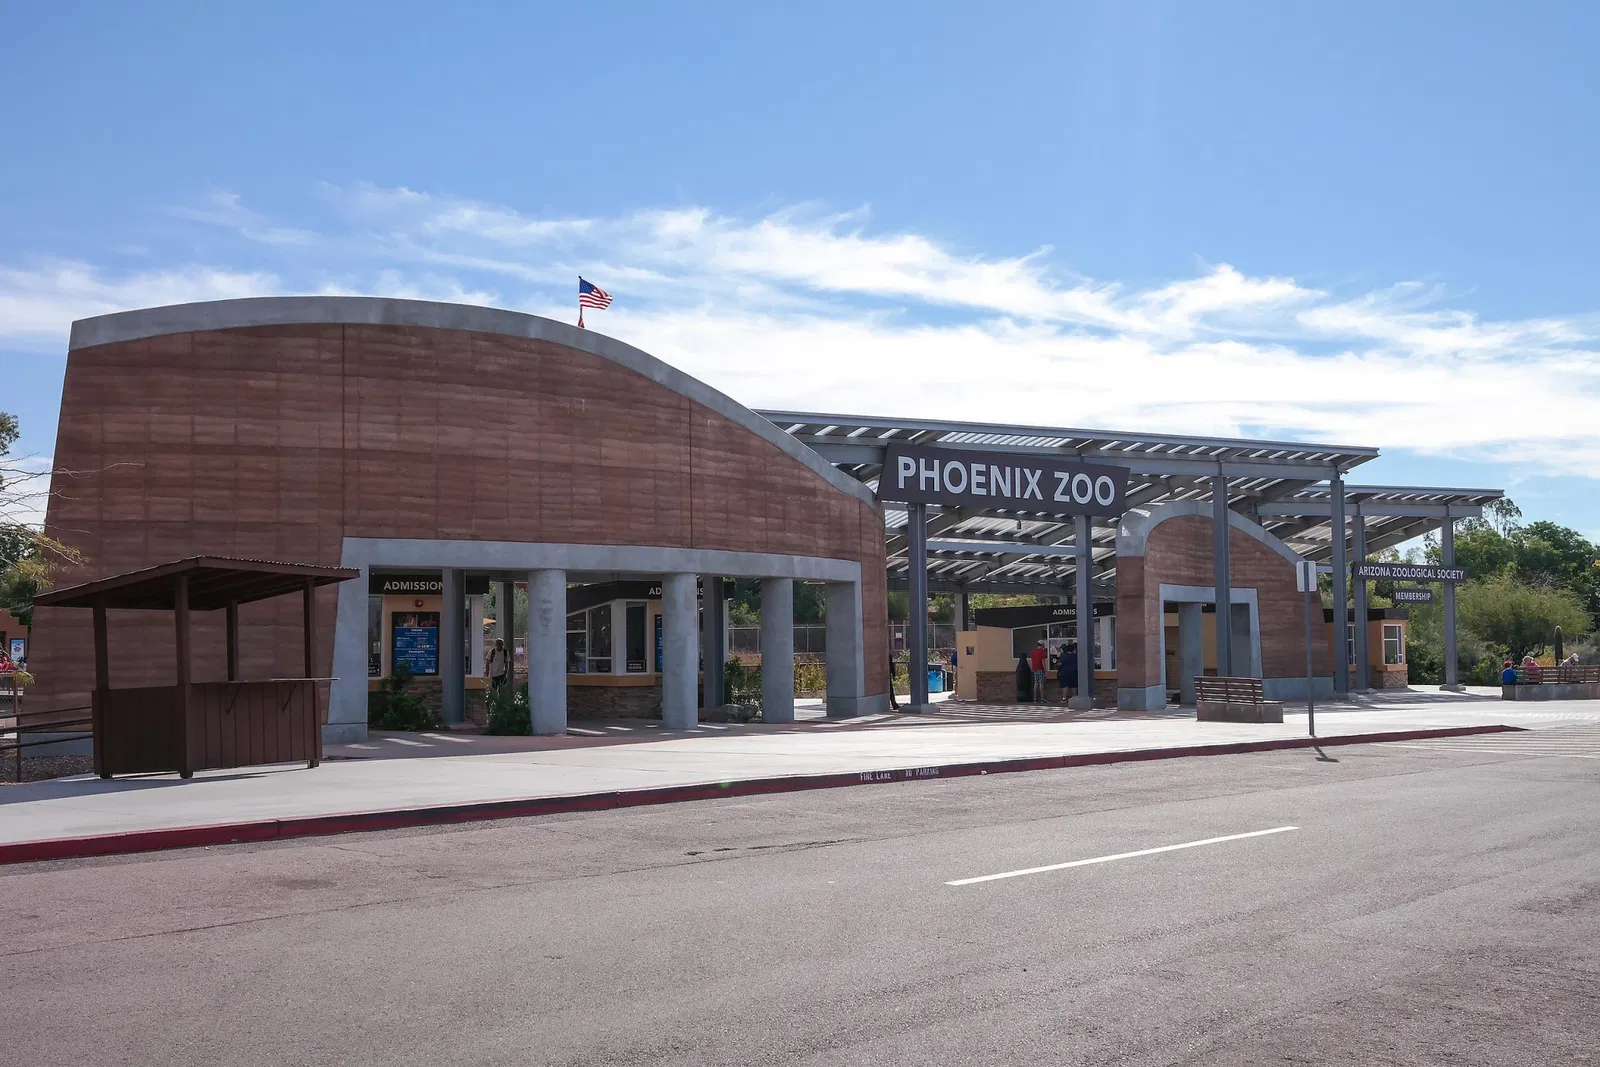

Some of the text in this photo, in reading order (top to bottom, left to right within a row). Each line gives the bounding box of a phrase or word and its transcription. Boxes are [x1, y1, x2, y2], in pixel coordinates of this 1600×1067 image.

[897, 455, 1116, 507] PHOENIX ZOO
[1358, 565, 1465, 580] ARIZONA ZOOLOGICAL SOCIETY
[1395, 591, 1432, 601] MEMBERSHIP
